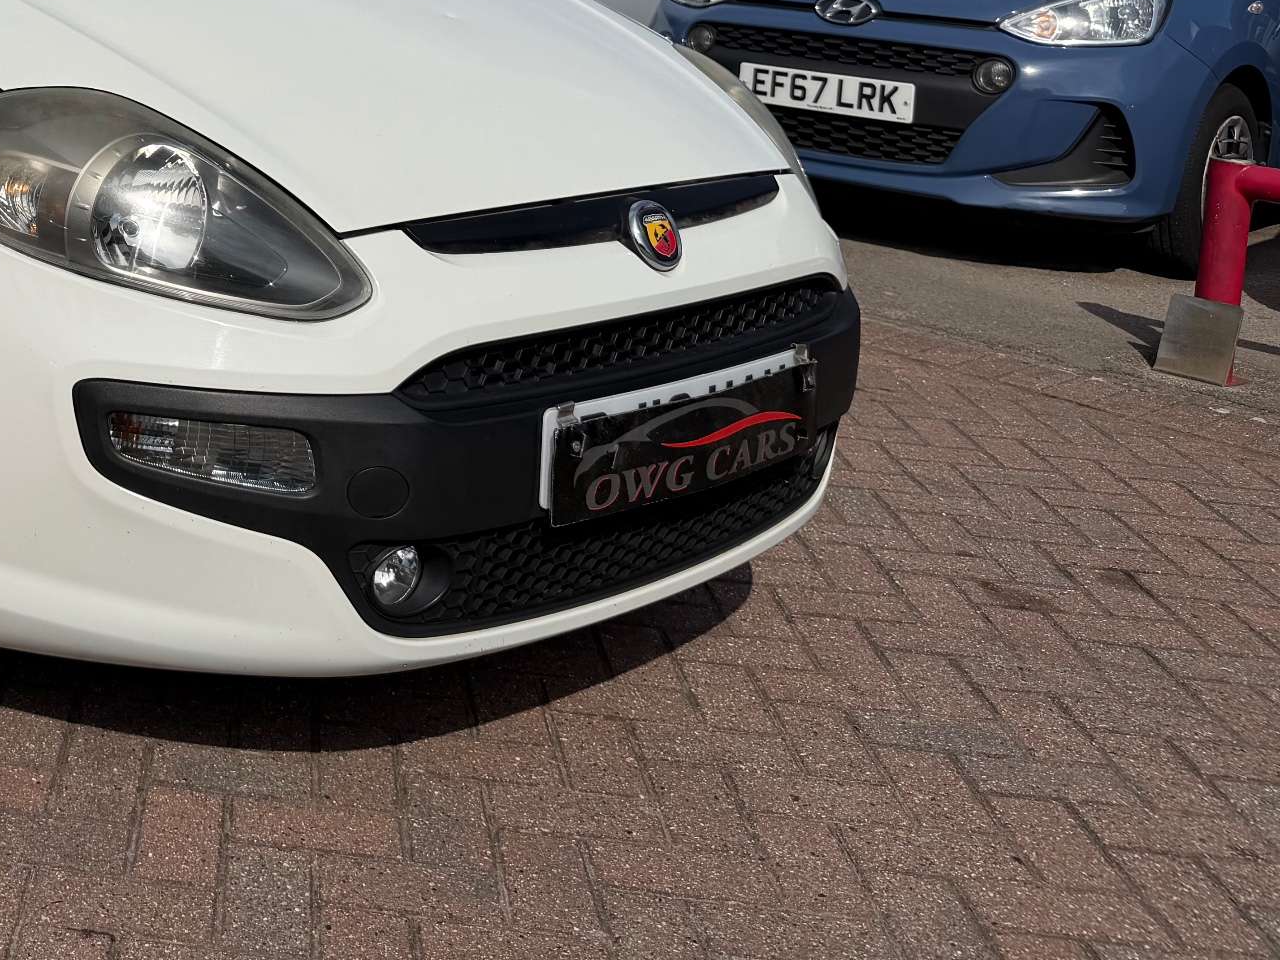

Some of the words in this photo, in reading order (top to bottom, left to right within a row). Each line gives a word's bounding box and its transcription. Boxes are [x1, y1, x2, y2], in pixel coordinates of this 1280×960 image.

[751, 67, 828, 104] EF67
[835, 78, 900, 115] LRK
[585, 454, 694, 511] OWG
[706, 422, 797, 481] CARS
